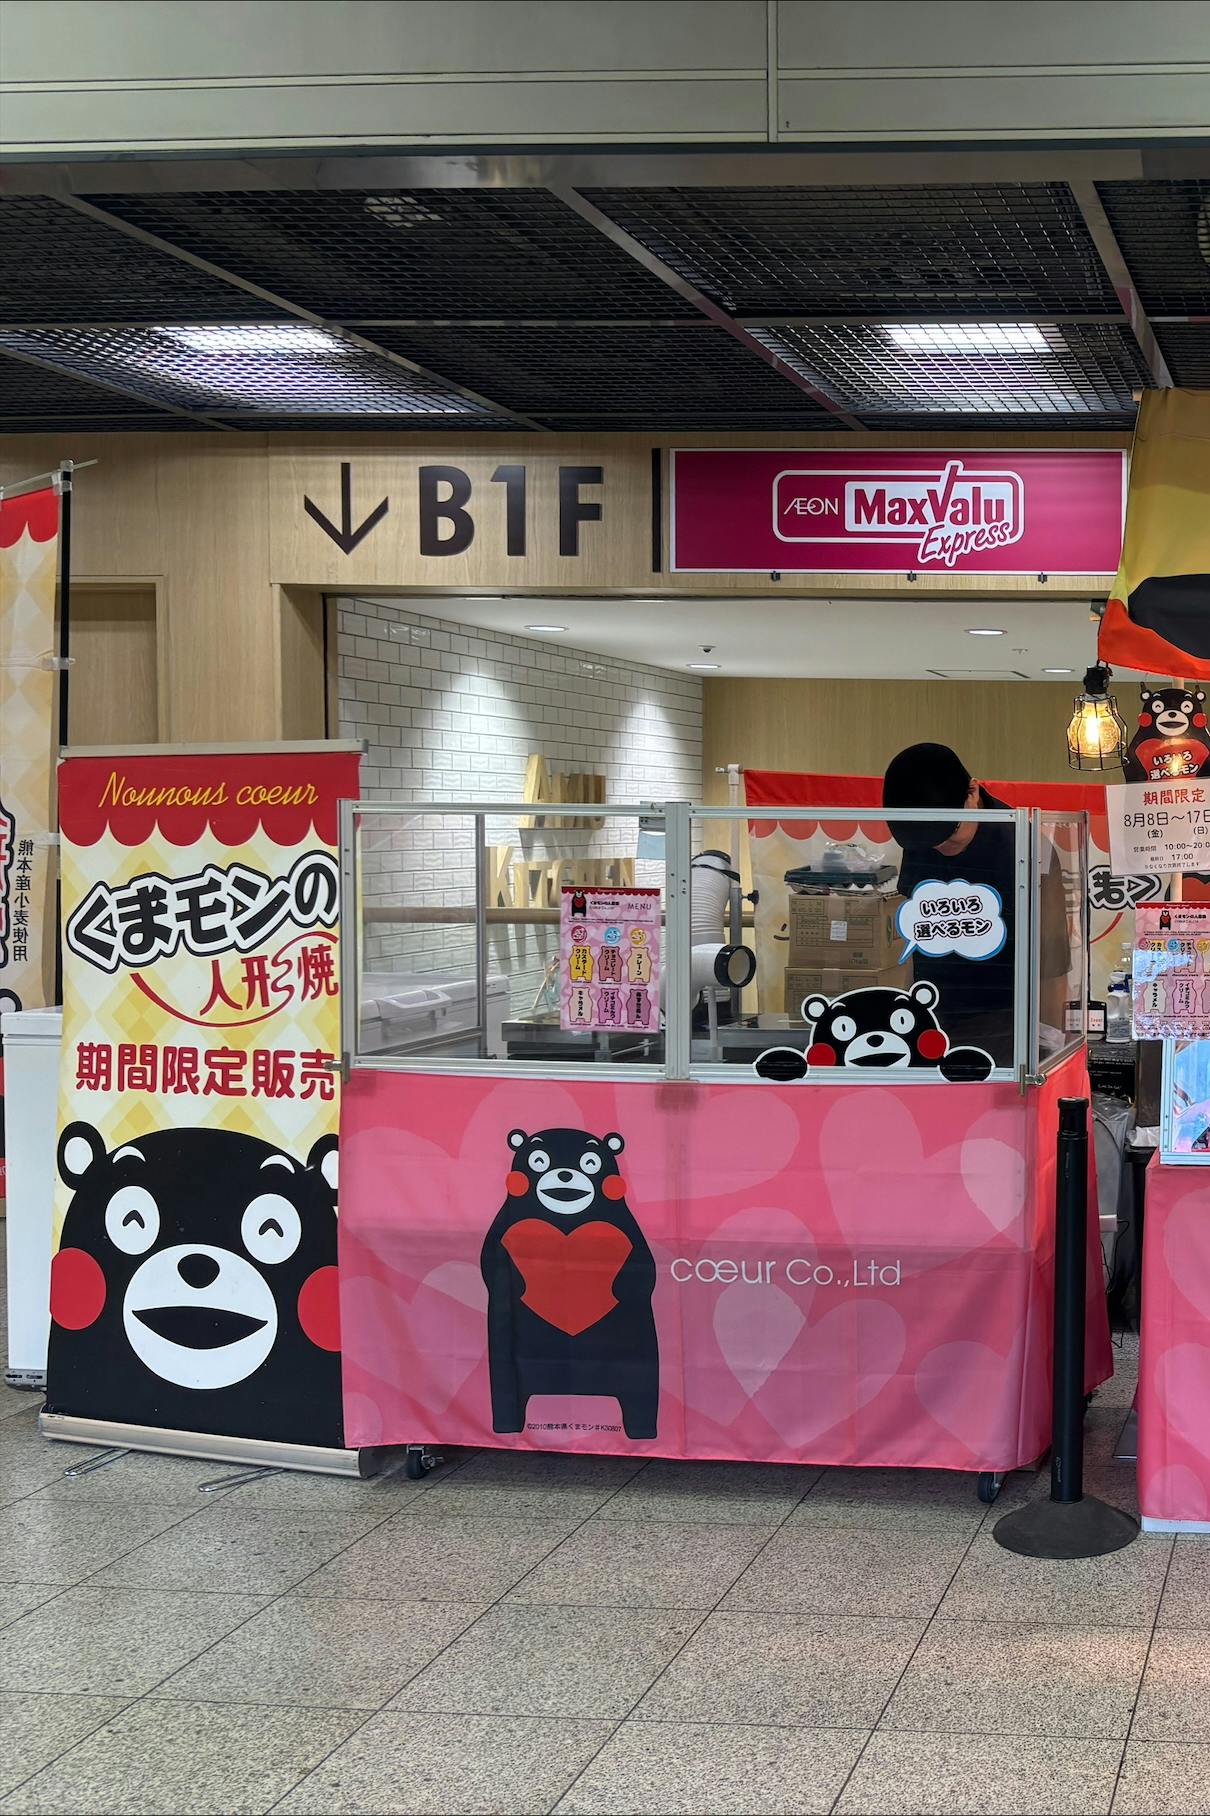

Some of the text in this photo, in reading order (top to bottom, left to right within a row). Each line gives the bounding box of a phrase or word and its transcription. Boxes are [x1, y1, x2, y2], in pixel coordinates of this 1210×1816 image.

[419, 465, 604, 557] B1F
[853, 463, 1006, 528] MaxValu
[921, 521, 1014, 562] Express
[1143, 788, 1205, 805] 期間限定
[70, 857, 339, 967] くまモンの
[627, 903, 652, 911] MENU
[913, 918, 991, 941] 選べるモン
[920, 896, 982, 917] いろいろ
[200, 943, 338, 1016] 人形焼
[76, 1041, 337, 1101] 期間限定販売
